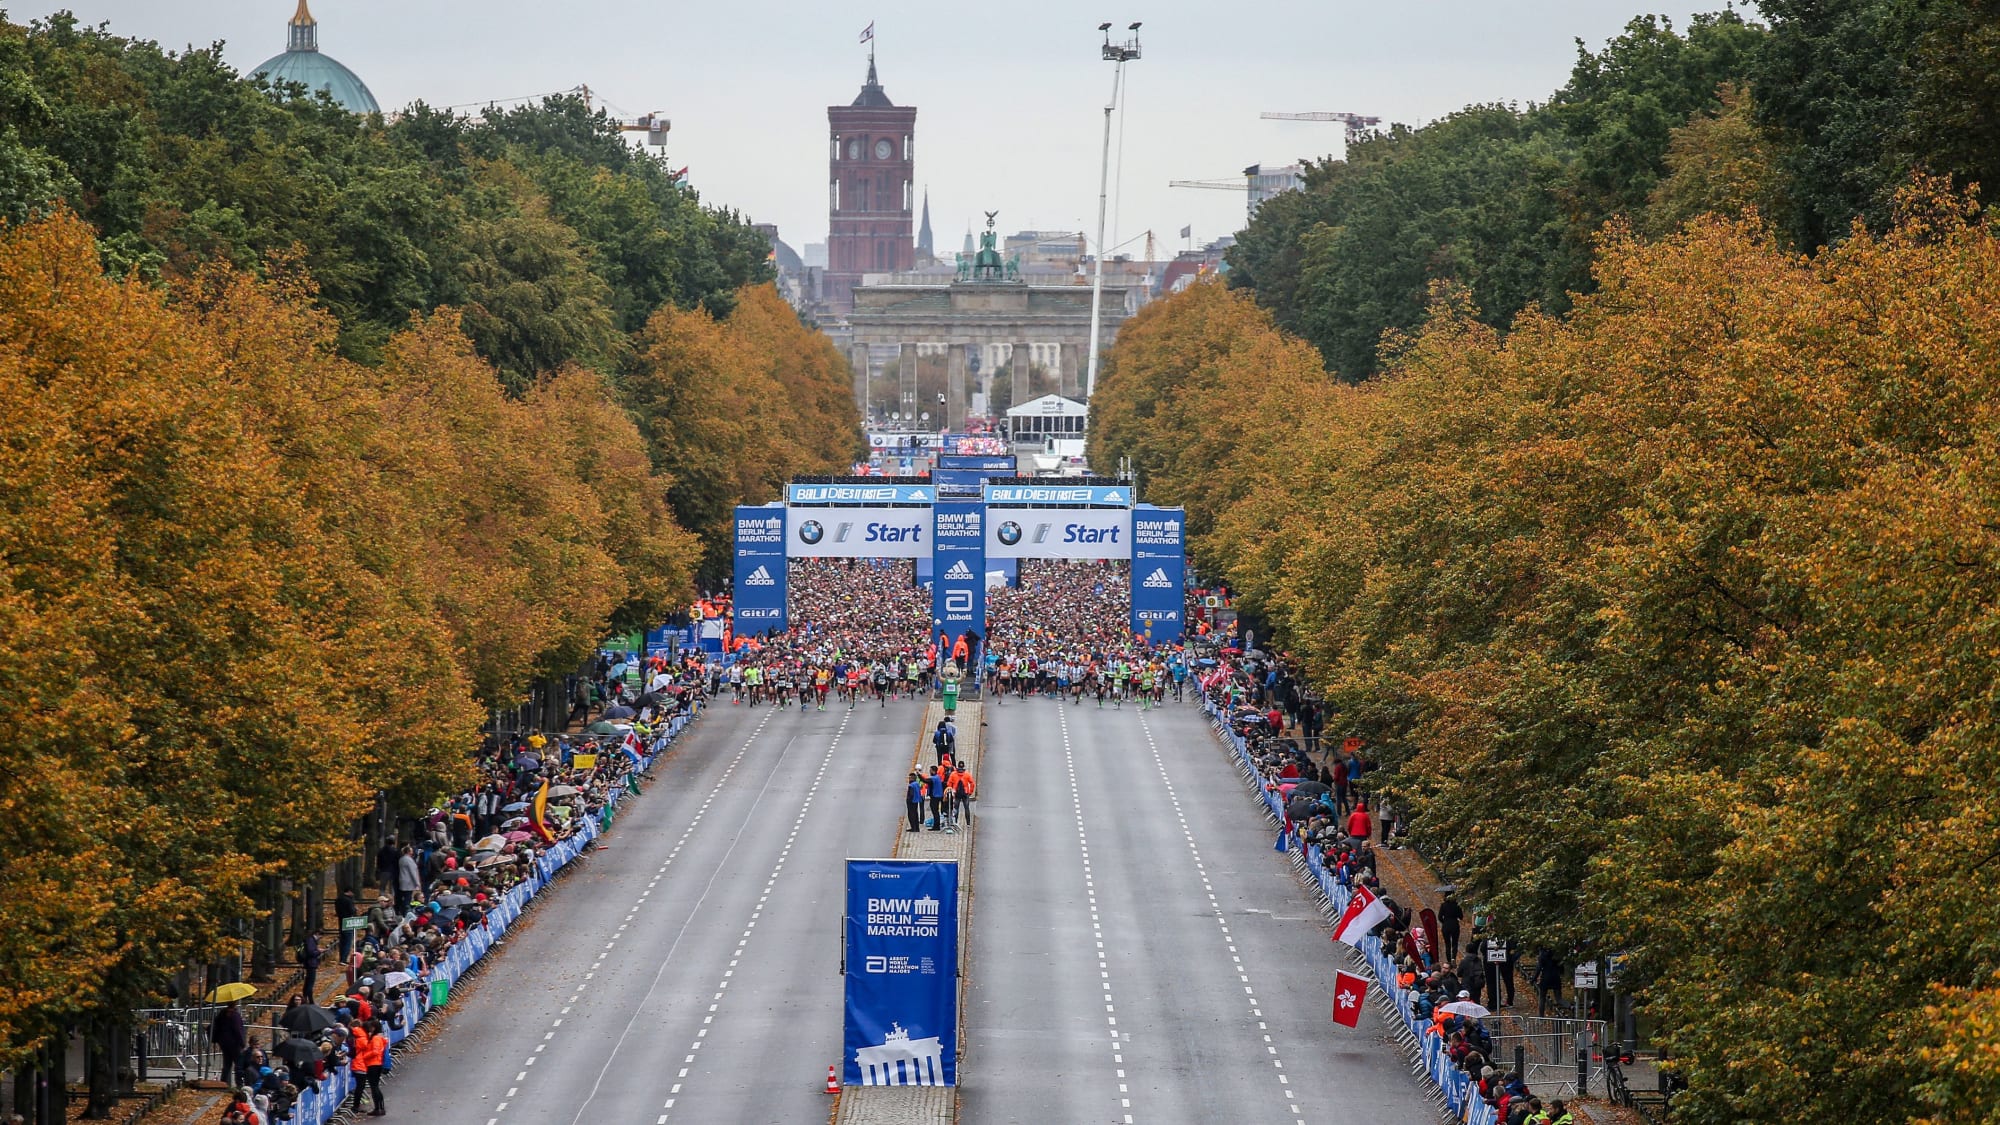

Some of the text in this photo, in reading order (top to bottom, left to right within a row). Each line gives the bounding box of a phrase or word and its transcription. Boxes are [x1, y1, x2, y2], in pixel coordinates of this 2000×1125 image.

[796, 488, 827, 499] BERLIN
[861, 488, 897, 499] FASTER
[1057, 489, 1092, 500] FASTER
[937, 514, 963, 522] BMW
[738, 520, 764, 528] BMW
[1136, 521, 1162, 530] BMW
[865, 523, 921, 542] Start
[1063, 524, 1120, 543] Start
[745, 577, 774, 585] adidas
[1143, 580, 1172, 588] adidas
[868, 898, 912, 912] BMW
[868, 914, 912, 924] BERLIN
[868, 926, 938, 936] MARATHON
